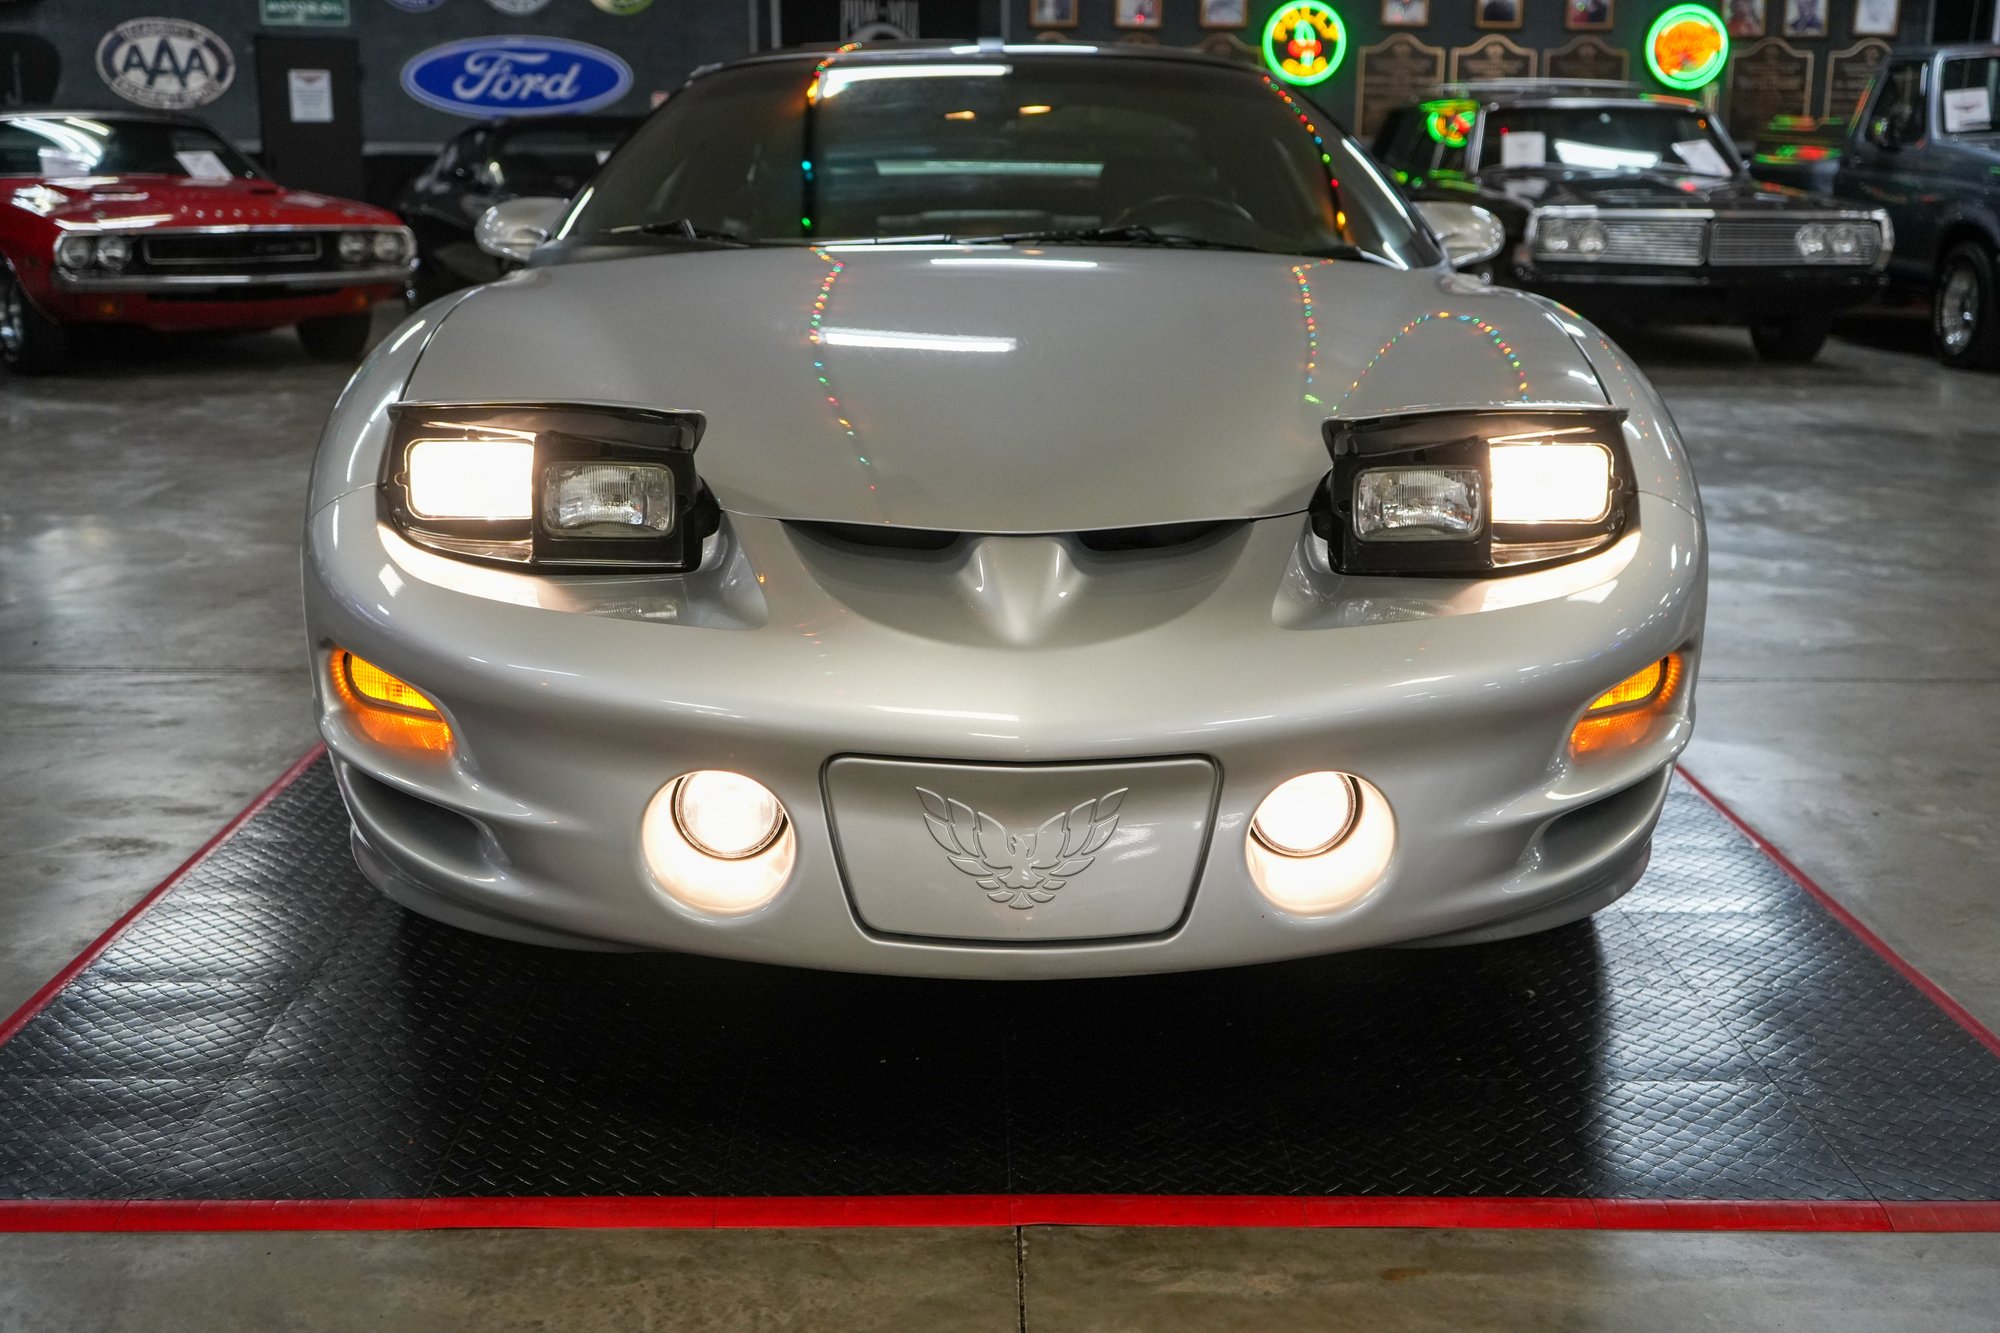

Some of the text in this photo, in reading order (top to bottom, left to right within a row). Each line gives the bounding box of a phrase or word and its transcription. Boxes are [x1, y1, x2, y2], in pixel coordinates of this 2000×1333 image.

[267, 1, 317, 14] MOTOR
[122, 37, 210, 89] AAA
[452, 50, 583, 100] Ford
